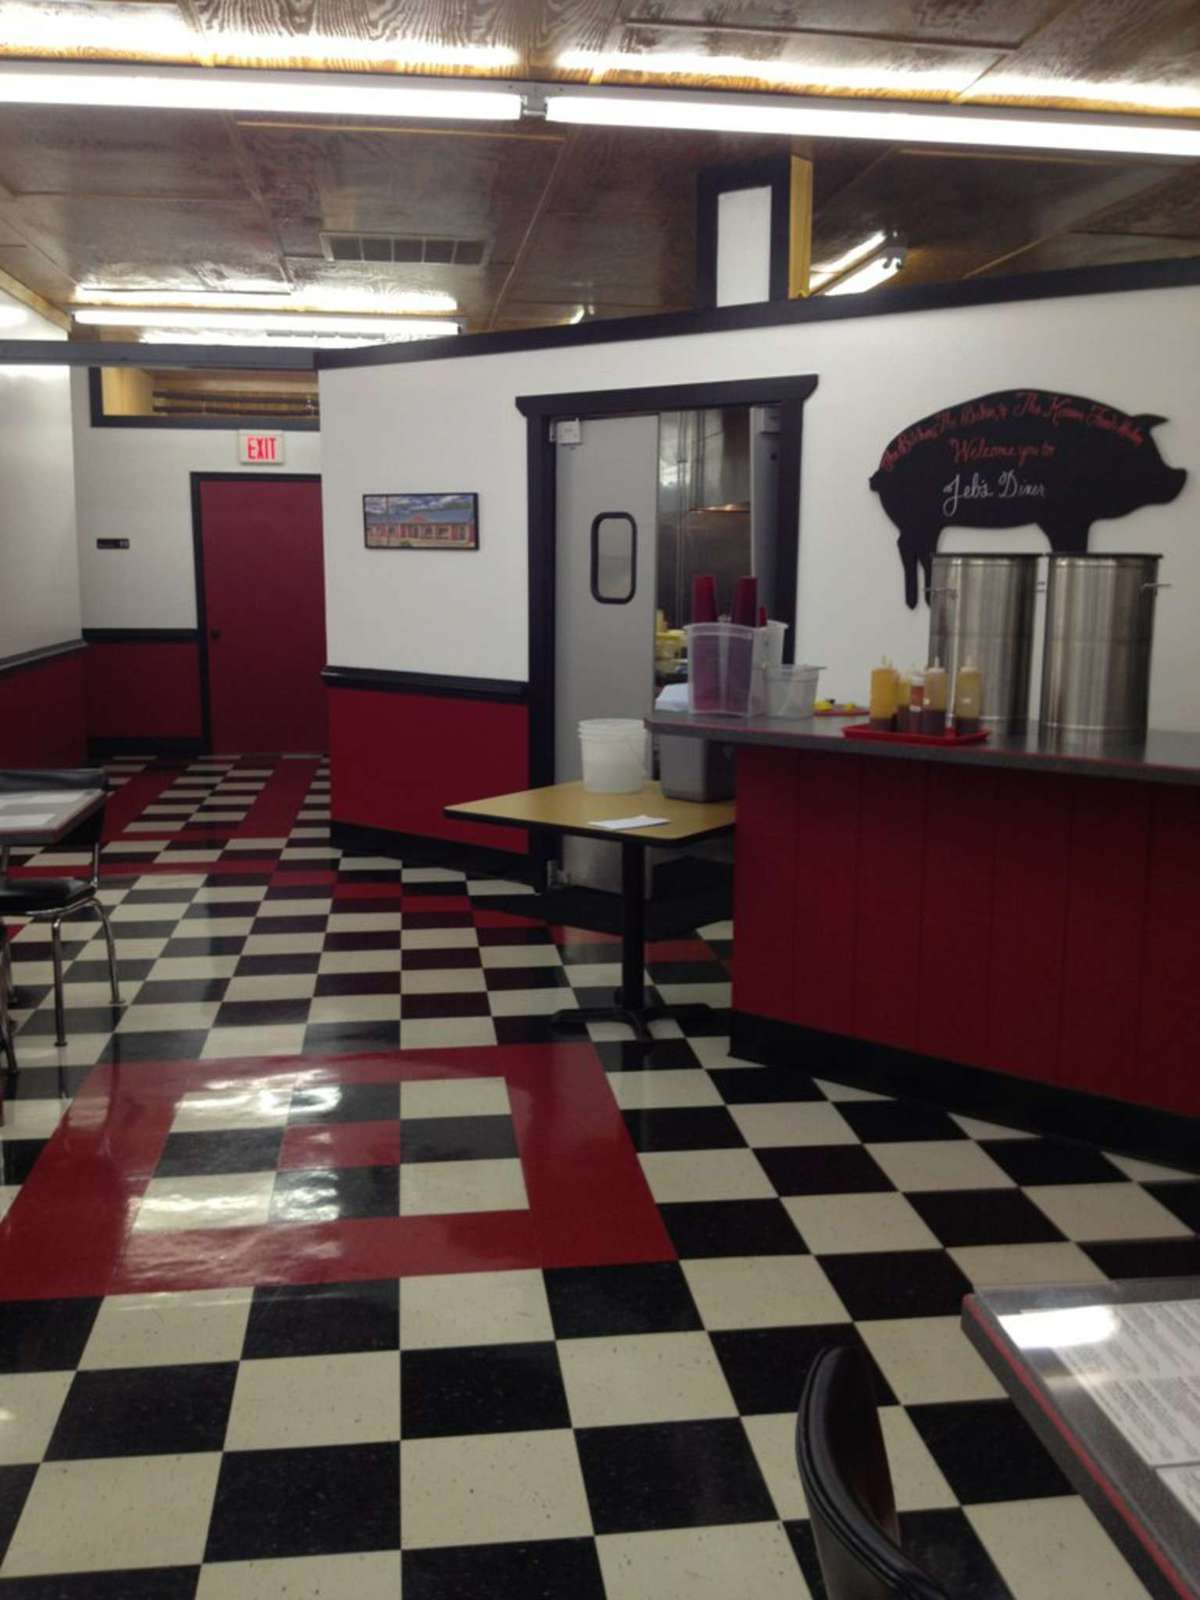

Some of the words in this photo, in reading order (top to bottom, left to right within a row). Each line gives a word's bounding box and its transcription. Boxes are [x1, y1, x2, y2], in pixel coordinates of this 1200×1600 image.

[247, 435, 277, 460] EXIT
[949, 437, 1015, 463] Welcome
[942, 473, 994, 517] Jeb's
[998, 469, 1045, 498] Diner
